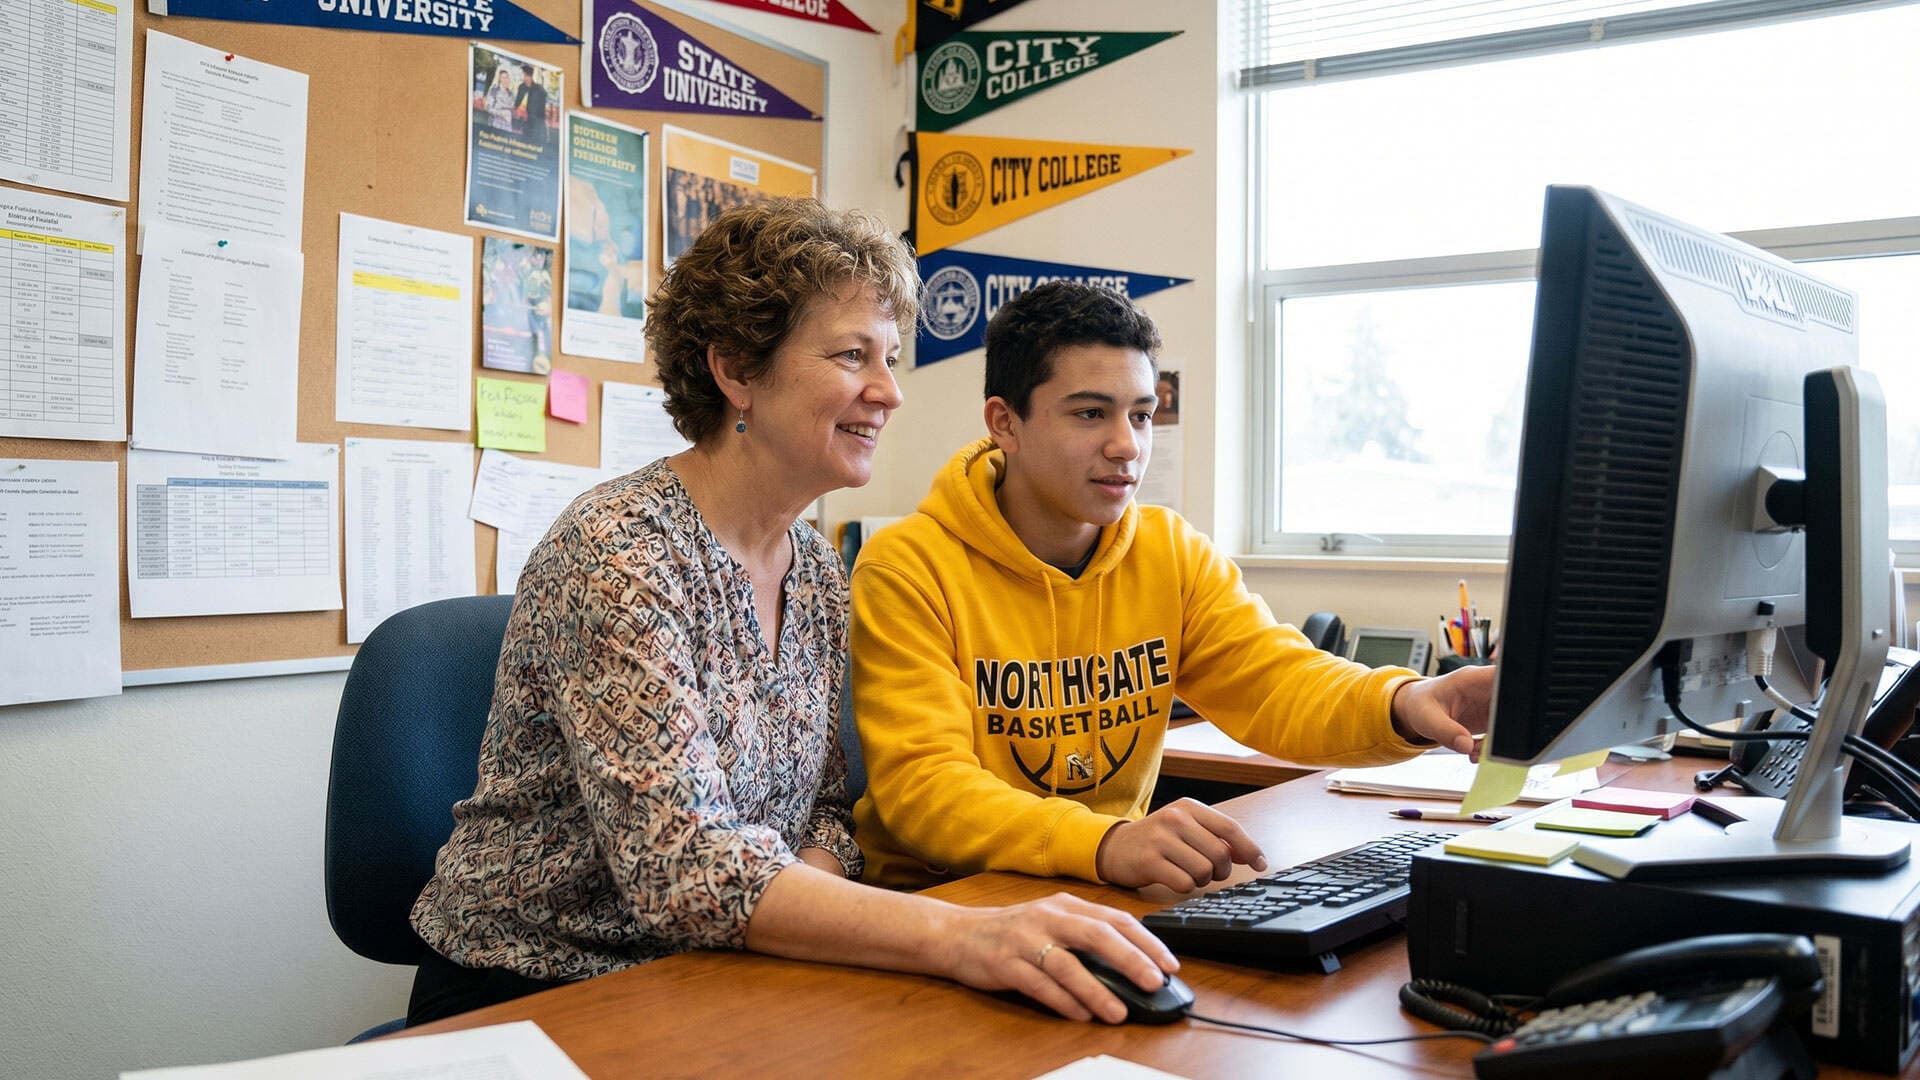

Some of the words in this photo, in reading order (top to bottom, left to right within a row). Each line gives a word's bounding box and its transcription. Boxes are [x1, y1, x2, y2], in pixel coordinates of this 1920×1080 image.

[318, 0, 494, 32] IVERSITY
[677, 39, 757, 96] STATE
[986, 36, 1102, 74] CITY
[986, 52, 1099, 100] COLLEGE
[662, 66, 768, 113] UNIVERSITY
[991, 156, 1033, 205] CITY
[1038, 153, 1121, 192] COLLEGE
[974, 636, 1171, 711] NORTHGATE
[987, 695, 1160, 739] BASKETBALL
